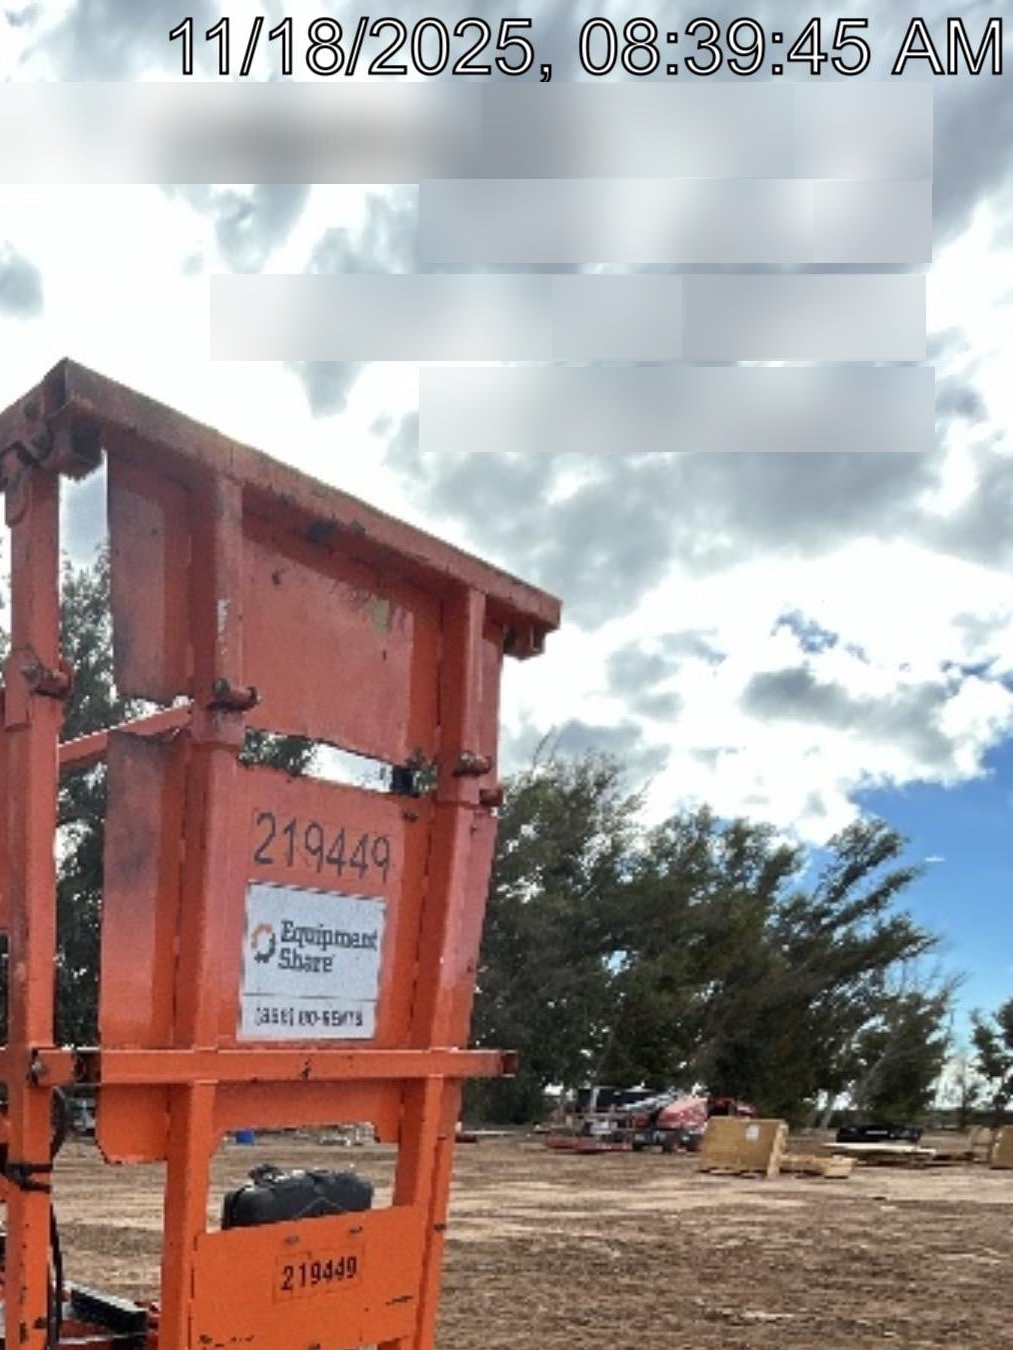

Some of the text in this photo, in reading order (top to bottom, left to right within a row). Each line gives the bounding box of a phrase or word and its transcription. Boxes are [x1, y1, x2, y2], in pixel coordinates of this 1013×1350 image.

[253, 811, 391, 883] 219449
[280, 920, 379, 951] Equipment
[277, 948, 335, 974] Share
[280, 1255, 358, 1292] 219449
